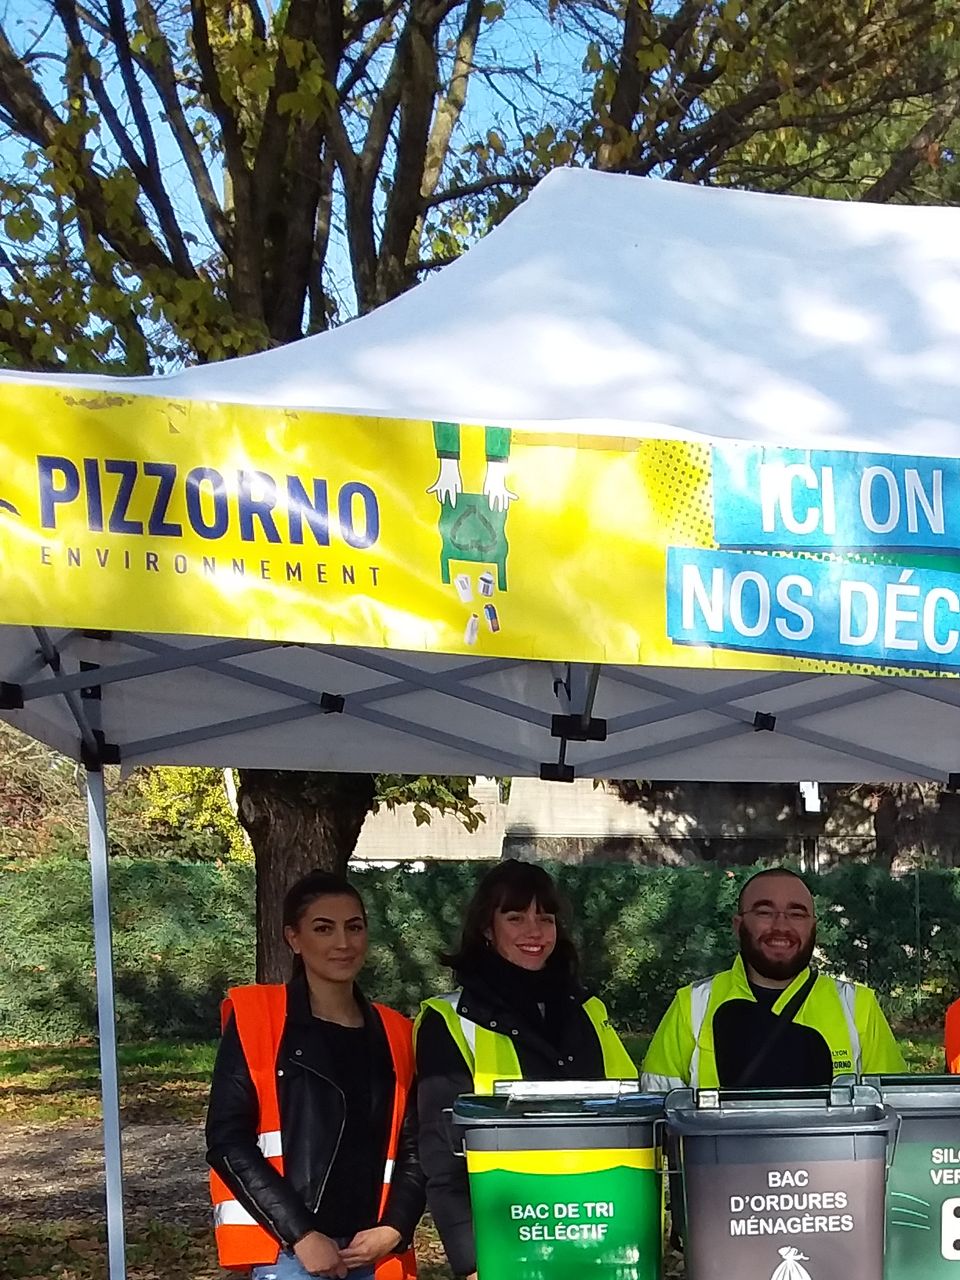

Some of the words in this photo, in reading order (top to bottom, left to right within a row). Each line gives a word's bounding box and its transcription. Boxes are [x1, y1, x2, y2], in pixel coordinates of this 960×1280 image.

[36, 455, 380, 549] PIZZORNO
[760, 463, 836, 534] ICI
[860, 466, 946, 536] ON
[41, 546, 381, 587] ENVIRONNEMENT
[681, 564, 815, 640] NOS
[768, 1170, 809, 1187] BAC
[511, 1204, 549, 1219] BAC
[554, 1203, 580, 1219] DE
[583, 1202, 614, 1218] TRI
[730, 1192, 848, 1212] D'ORDURES
[519, 1222, 608, 1241] SÉLÉCTIF
[730, 1213, 854, 1236] MÉNAGÈRES
